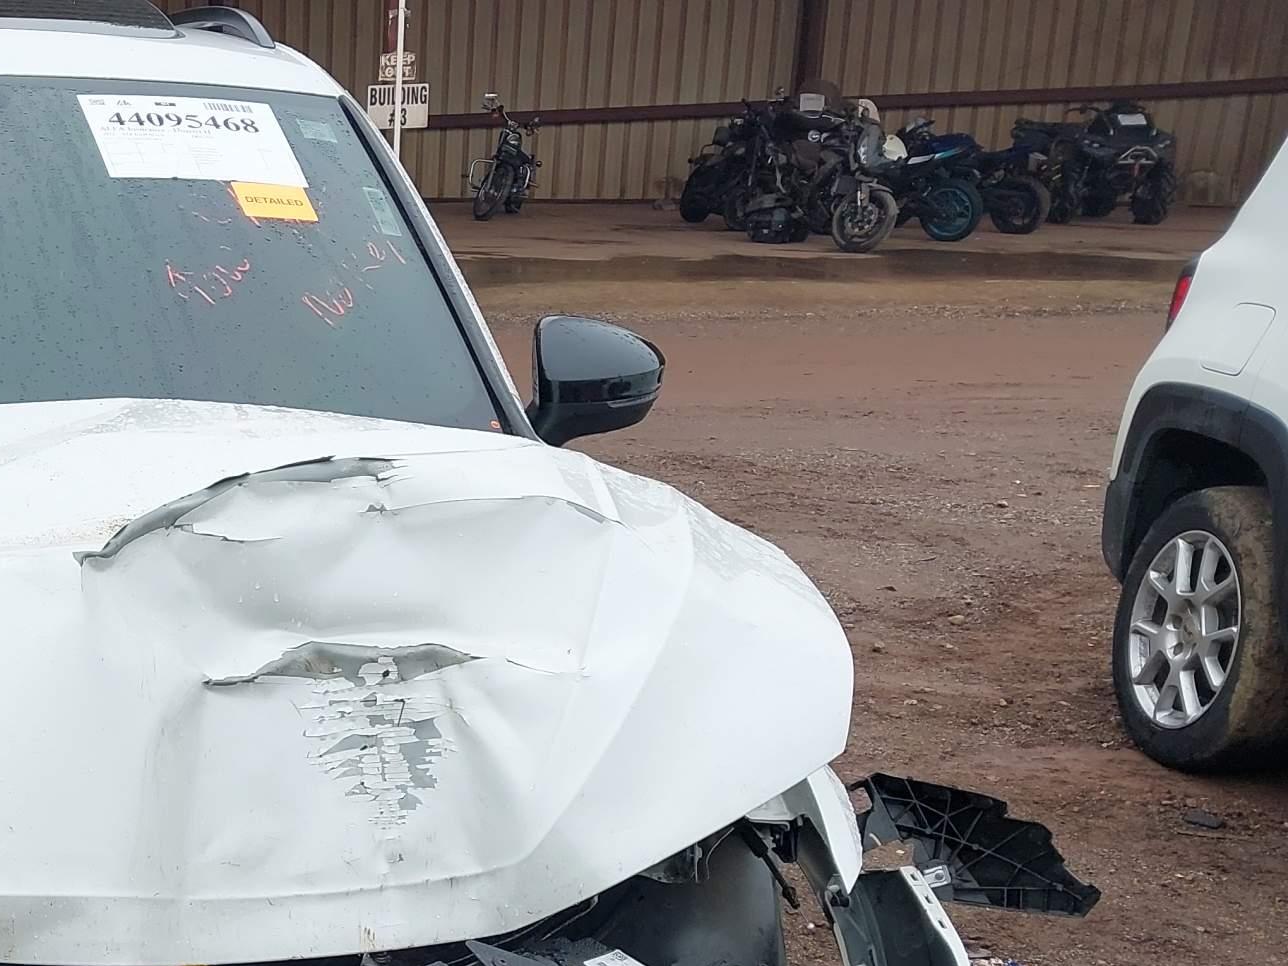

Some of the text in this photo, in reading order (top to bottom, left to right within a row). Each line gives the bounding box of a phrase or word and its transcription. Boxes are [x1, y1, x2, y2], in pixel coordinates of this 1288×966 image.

[370, 86, 427, 106] BUILDING
[108, 111, 260, 134] 44095468
[244, 195, 304, 208] DETAILED
